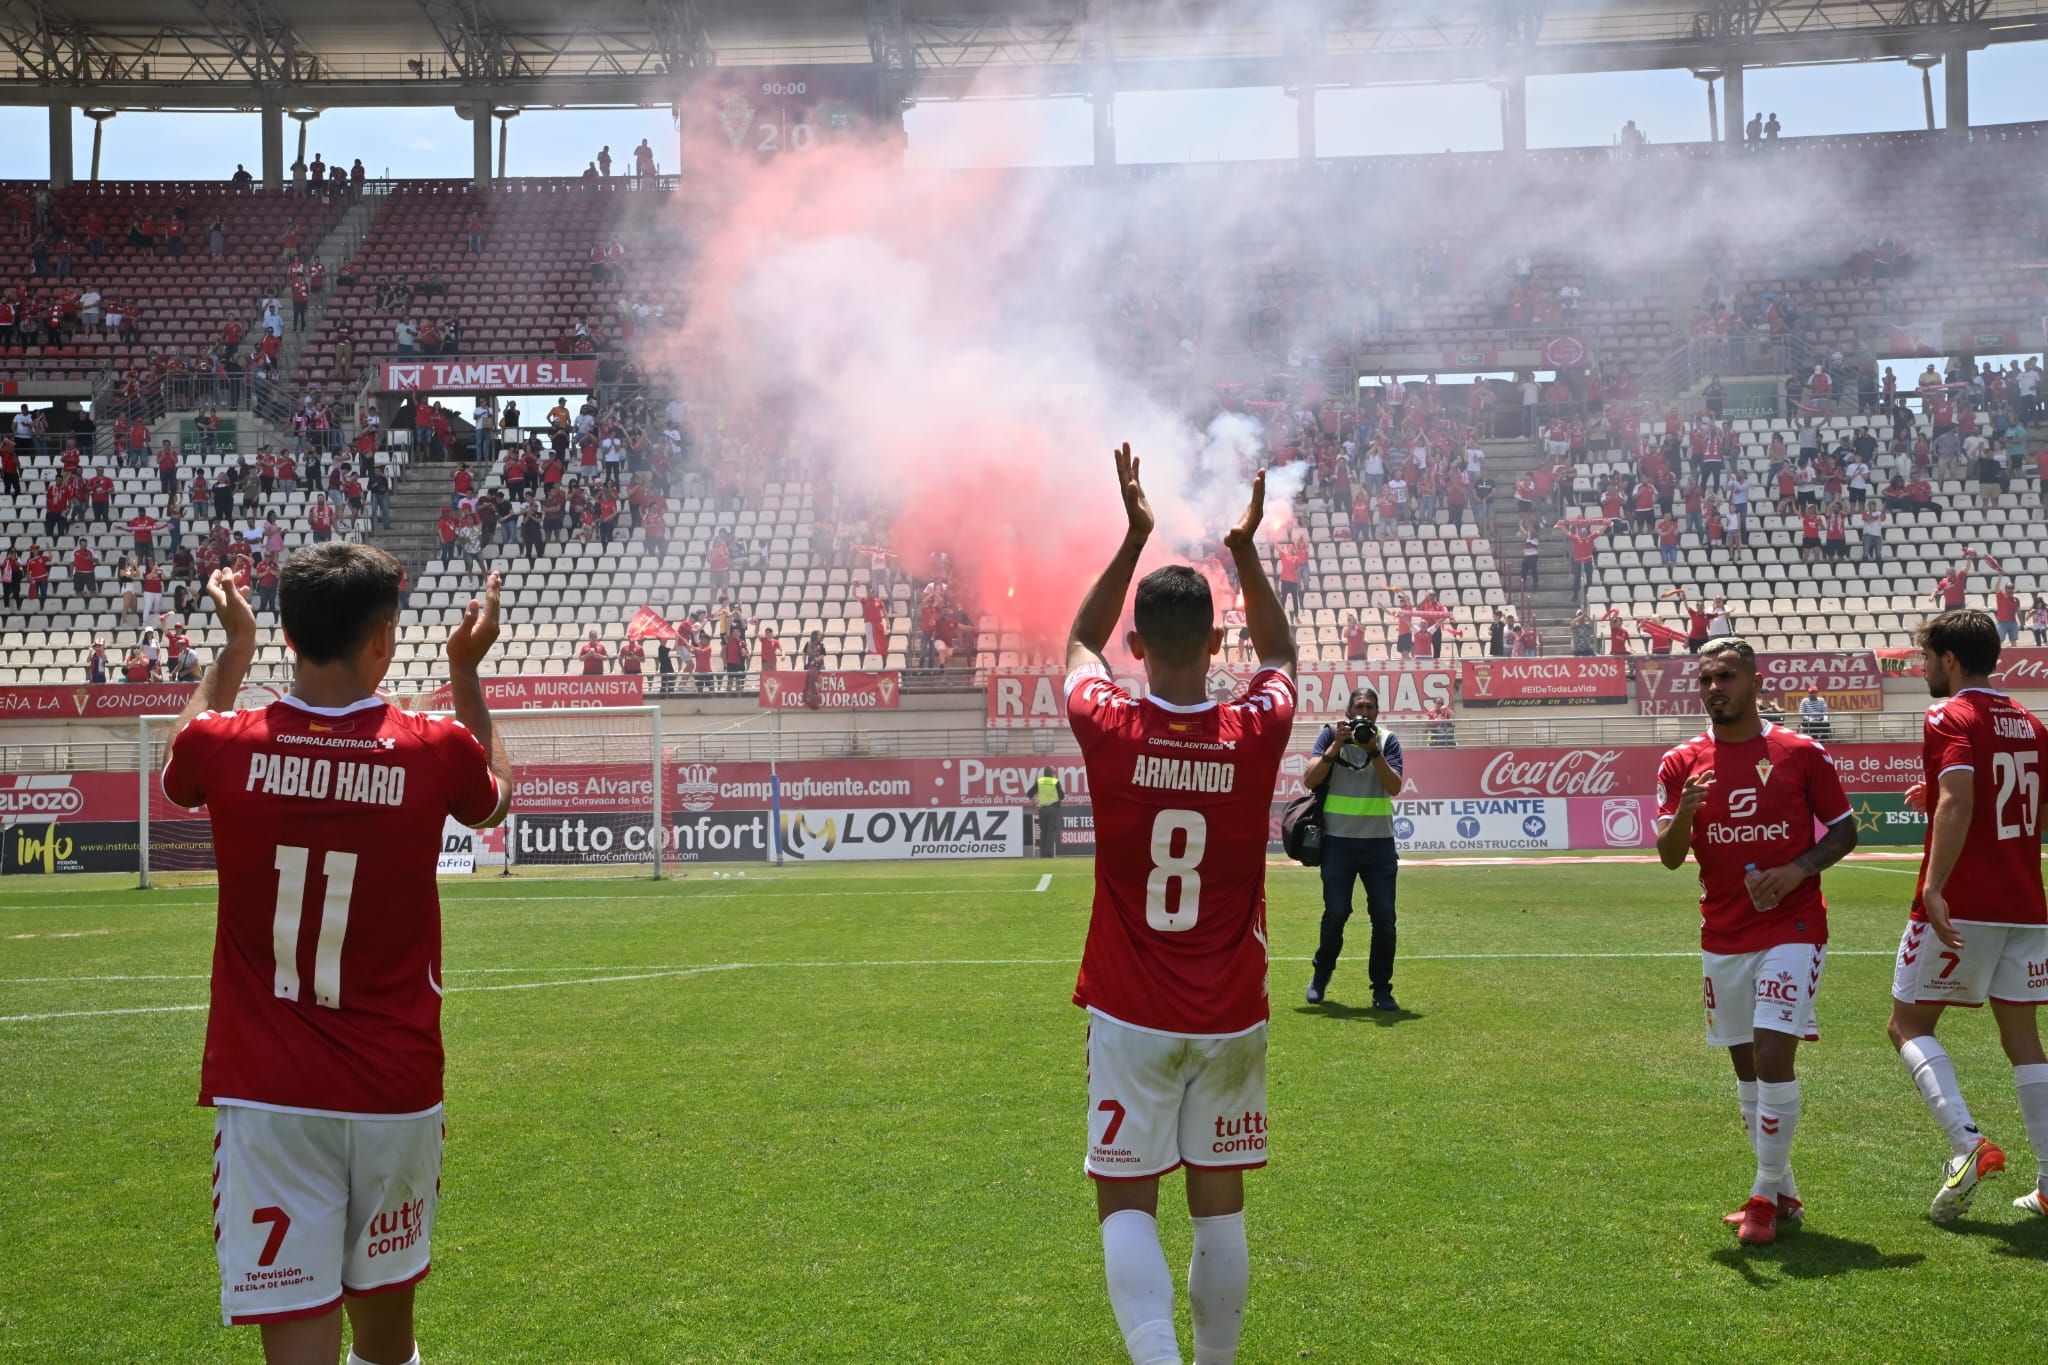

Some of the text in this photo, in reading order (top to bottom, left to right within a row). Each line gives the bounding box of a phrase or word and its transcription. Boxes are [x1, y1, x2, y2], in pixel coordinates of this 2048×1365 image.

[762, 82, 807, 96] 90:00
[757, 123, 779, 151] 2
[791, 123, 815, 152] 0
[432, 363, 582, 385] TAMEVI S.L.
[1502, 663, 1618, 680] MURCIA 2008
[1768, 658, 1868, 674] GRANA
[485, 680, 638, 699] PEÑA MURCIANISTA
[820, 673, 846, 691] EÑA
[1762, 675, 1819, 692] CON
[1827, 674, 1880, 690] DEL
[96, 693, 189, 708] CONDOMIN
[781, 691, 877, 706] LOS OLORAOS
[1297, 672, 1451, 713] RANAS
[37, 696, 60, 709] LA
[522, 700, 542, 710] DE
[1640, 698, 1695, 715] REAL
[276, 734, 378, 749] COMPRALAENTRADA
[1148, 737, 1224, 751] COMPRALAENTRADA
[1834, 754, 1924, 771] ria de Jesú
[246, 752, 406, 806] PABLO HARO
[1131, 754, 1235, 793] ARMANDO
[1839, 771, 1926, 783] rio-Crematori
[511, 776, 655, 796] uebles Alvare
[720, 777, 911, 801] campngfuente.com
[564, 799, 570, 809] y
[572, 796, 616, 806] Caravaca
[618, 795, 629, 804] de
[631, 795, 640, 804] la
[960, 795, 991, 805] Servicio
[993, 795, 1003, 804] de
[1992, 750, 2040, 841] 25
[1391, 799, 1545, 816] VENT LEVANTE
[1062, 815, 1095, 828] THE TES
[1884, 811, 1929, 824] EST
[519, 816, 766, 853] tutto confort
[842, 811, 1010, 844] LOYMAZ
[1706, 820, 1790, 844] fibranet
[18, 822, 73, 873] info
[443, 835, 472, 853] DA
[911, 841, 1006, 857] promociones
[1394, 838, 1549, 850] OS PARA CONSTRUCCIÓN
[438, 858, 471, 868] aFrio
[581, 850, 699, 863] TuttoConfortMcia.com
[1146, 808, 1207, 932] 8
[273, 844, 358, 1010] 11
[1939, 951, 1961, 979] 7
[2027, 978, 2048, 989] con
[1097, 1099, 1126, 1145] 7
[1093, 1146, 1132, 1156] Televisión
[252, 1206, 291, 1267] 7
[245, 1267, 302, 1282] Televisión
